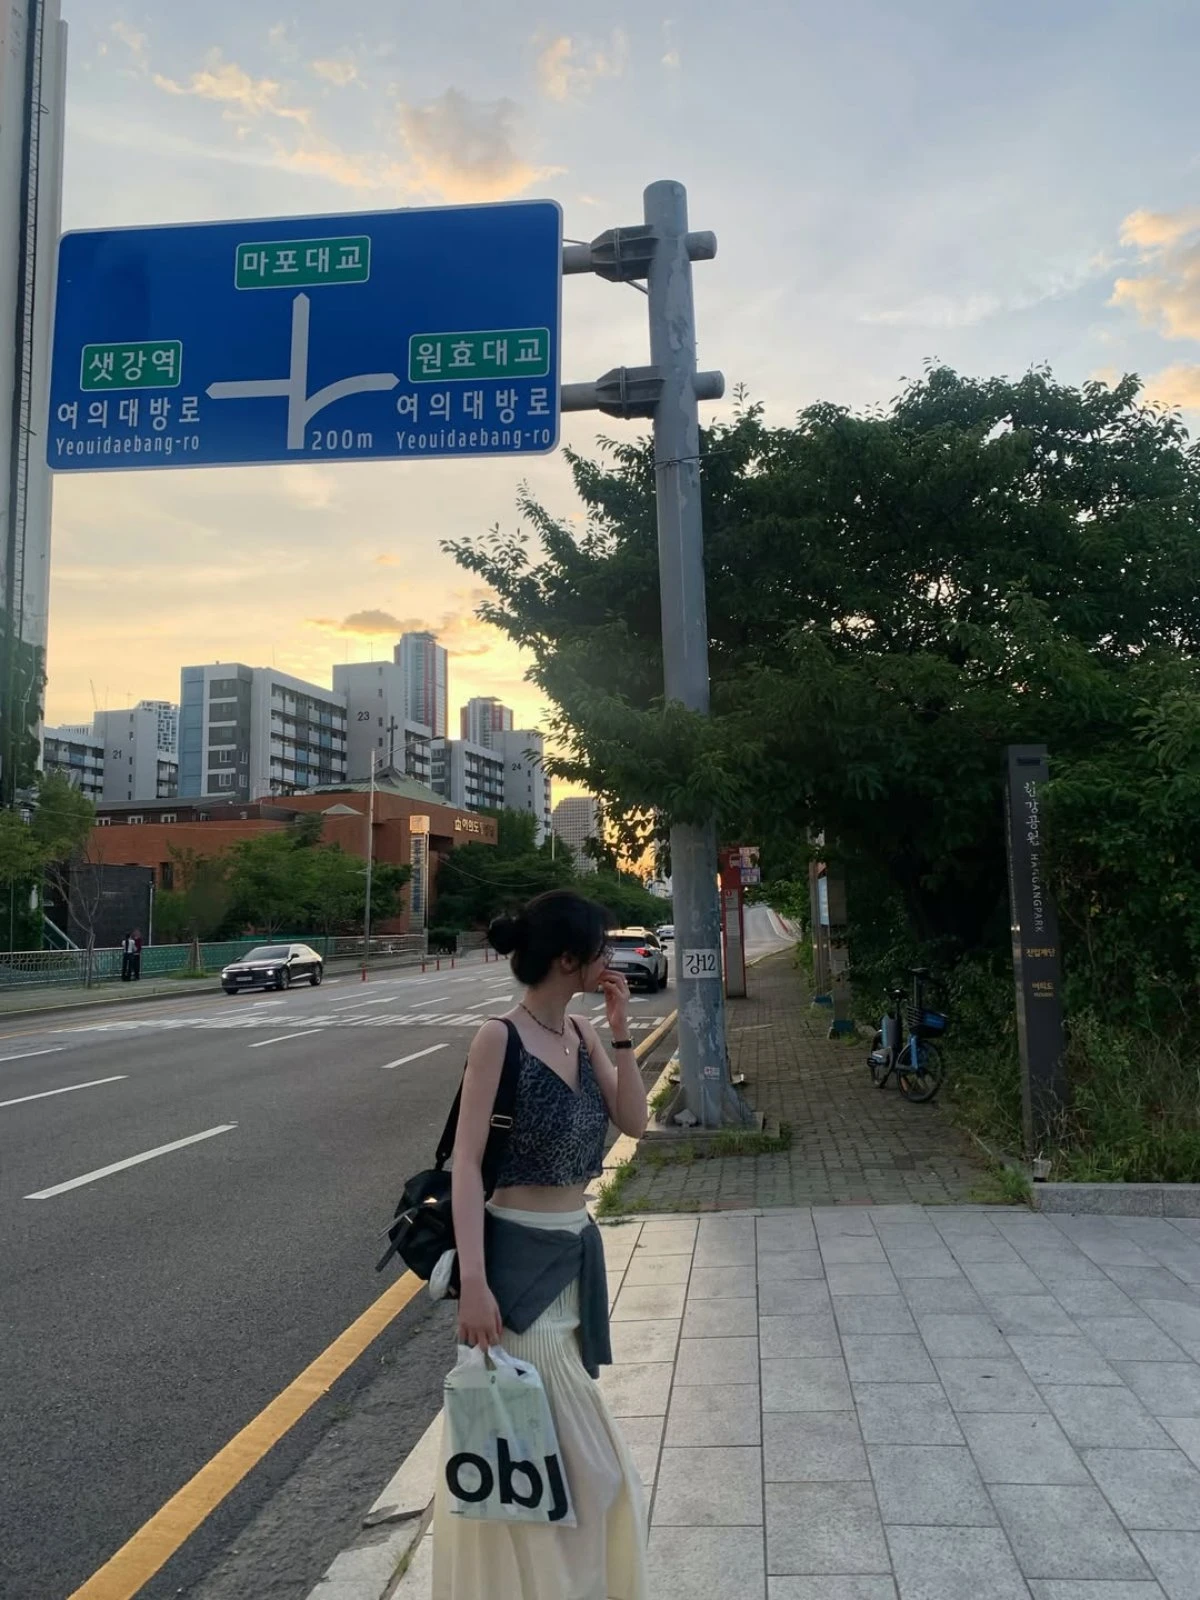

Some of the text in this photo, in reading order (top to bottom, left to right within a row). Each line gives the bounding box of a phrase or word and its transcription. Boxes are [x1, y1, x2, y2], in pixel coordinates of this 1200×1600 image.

[242, 246, 363, 277] 마포대교
[88, 348, 176, 382] 샛강역
[416, 338, 543, 374] 원효대교
[57, 395, 201, 432] 여의대방로
[396, 387, 551, 425] 여의대방로
[56, 434, 200, 456] Yeouidaebang-ro
[311, 429, 373, 451] 200m
[396, 428, 551, 450] Yeouidaebang-ro
[357, 711, 370, 722] 23
[112, 749, 122, 760] 21
[511, 762, 522, 772] 24
[685, 953, 716, 975] 강12
